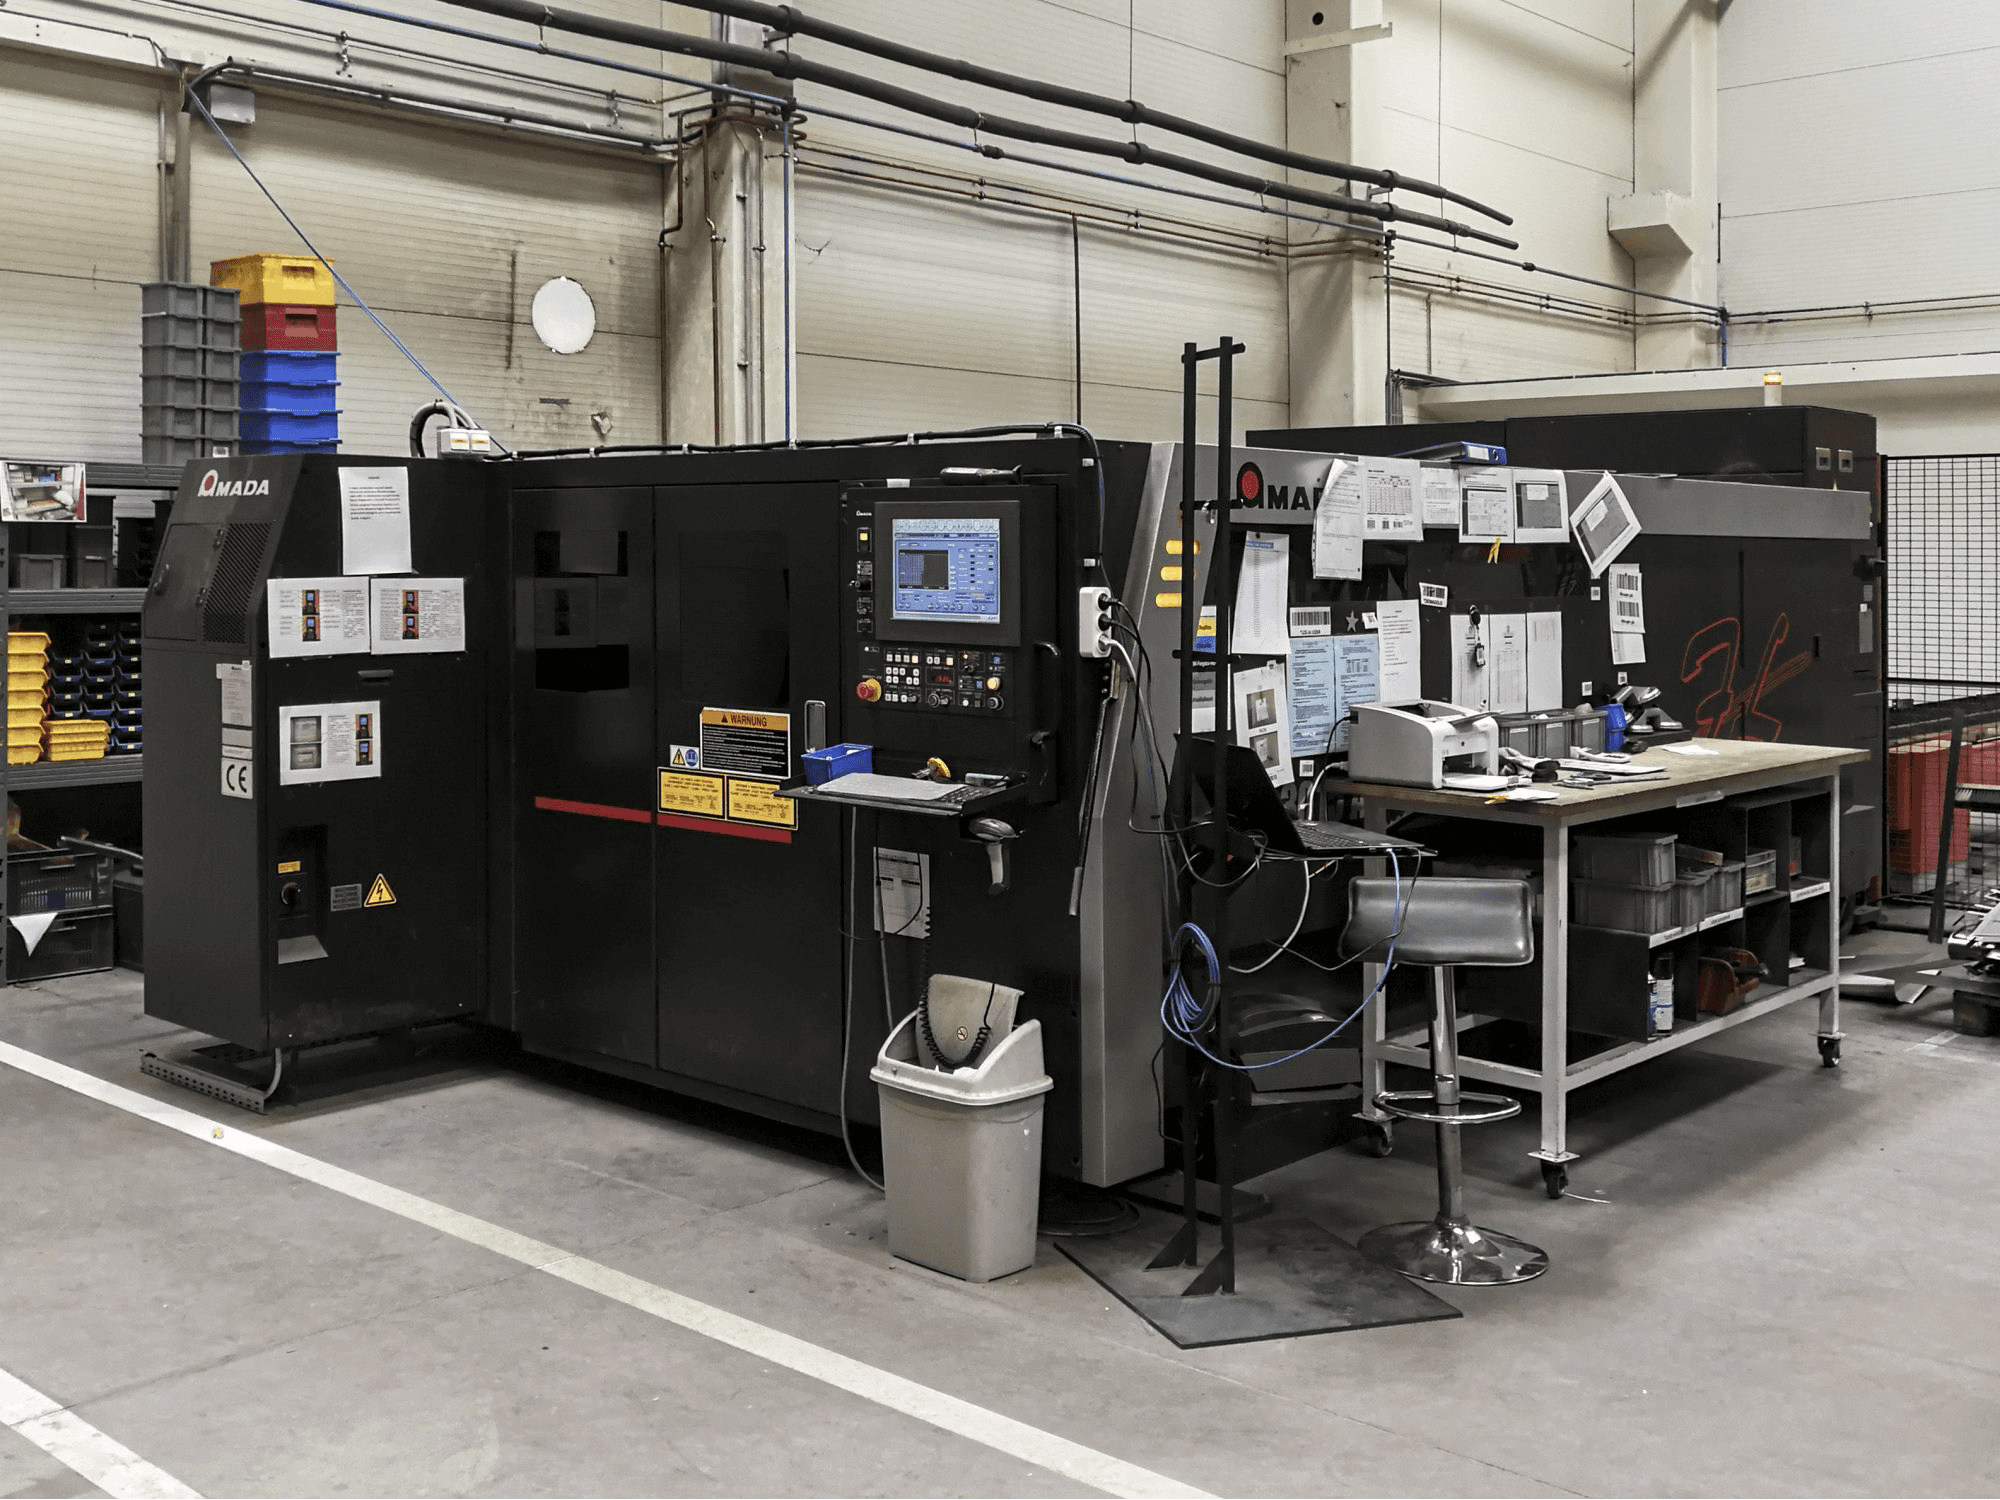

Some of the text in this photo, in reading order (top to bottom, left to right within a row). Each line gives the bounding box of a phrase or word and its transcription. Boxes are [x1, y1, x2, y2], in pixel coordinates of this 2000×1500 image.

[197, 469, 269, 497] AMADA
[730, 714, 768, 727] WARNUNG
[226, 764, 247, 794] CE
